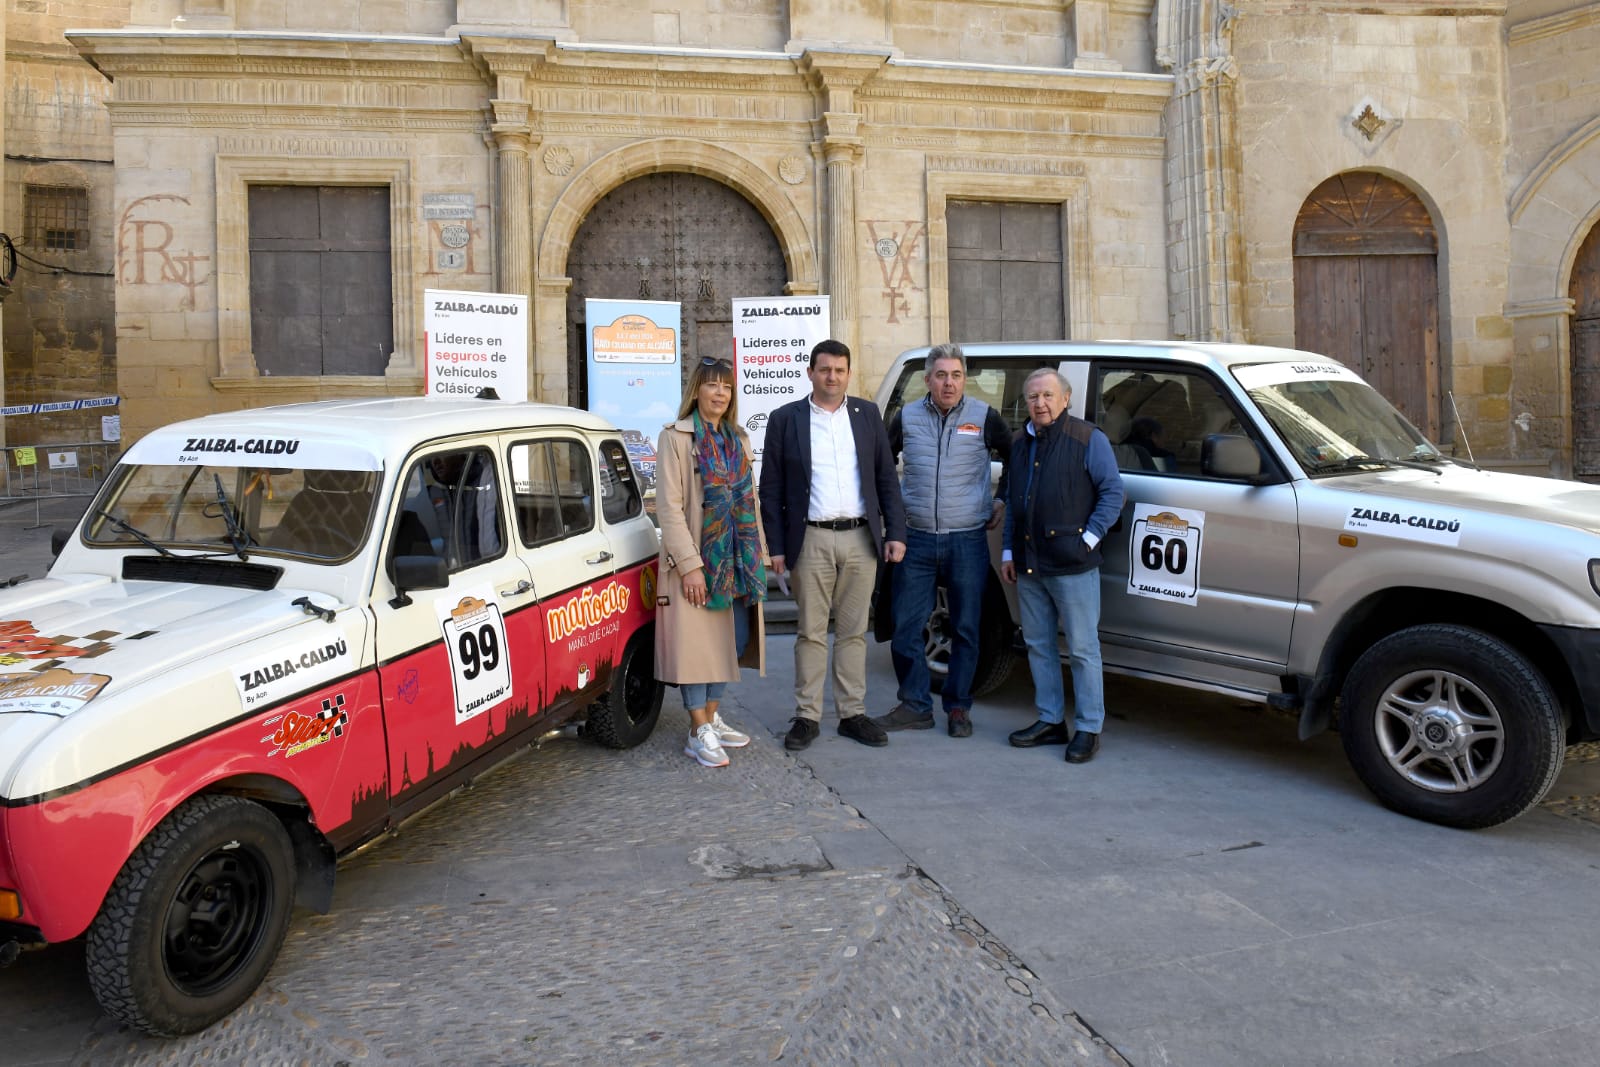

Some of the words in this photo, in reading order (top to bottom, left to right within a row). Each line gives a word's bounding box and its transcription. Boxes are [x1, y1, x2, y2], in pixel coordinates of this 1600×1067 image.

[434, 301, 518, 315] ZALBA-CALDÚ
[742, 304, 821, 317] ZALBA-CALDÚ
[486, 337, 502, 346] en
[790, 338, 806, 347] en
[435, 351, 488, 363] seguros
[490, 352, 507, 363] de
[743, 355, 792, 366] seguros
[794, 353, 810, 363] de
[435, 366, 498, 379] Vehículos
[435, 381, 485, 394] Clásico
[743, 384, 795, 395] Clásicos
[182, 437, 300, 455] ZALBA-CALDÚ
[1352, 508, 1460, 532] ZALBA-CALDÚ
[1141, 534, 1188, 575] 60
[1139, 584, 1186, 598] ZALBA-CALDÚ
[547, 581, 630, 643] mañocao
[458, 623, 499, 680] 99
[240, 636, 347, 692] ZALBA-CALDÚ
[246, 695, 255, 703] By
[255, 690, 268, 699] Aon
[465, 687, 504, 712] ZALBA-CALDÚ
